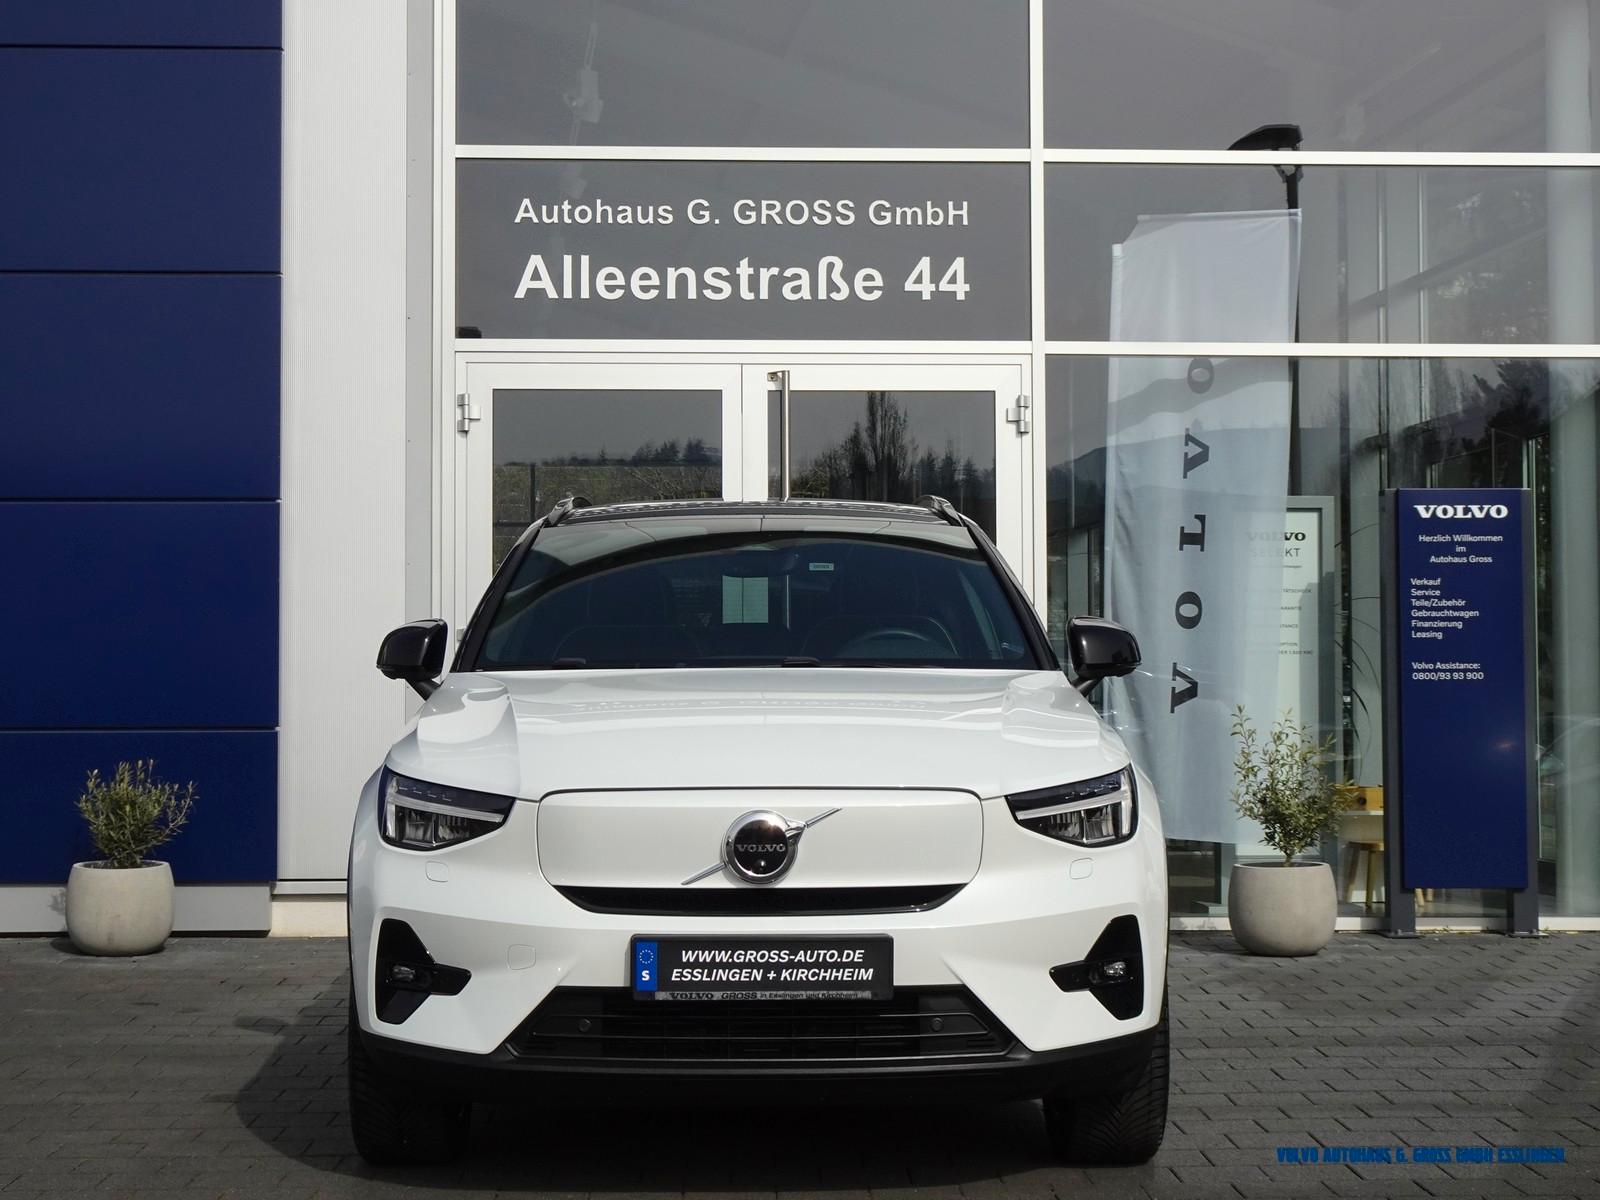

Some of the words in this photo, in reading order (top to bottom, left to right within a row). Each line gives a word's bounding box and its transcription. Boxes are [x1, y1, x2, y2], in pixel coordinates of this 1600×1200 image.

[513, 198, 674, 225] Autohaus
[687, 198, 720, 226] G.
[733, 199, 856, 226] GROSS
[868, 199, 969, 226] GmbH
[513, 254, 884, 302] Alleenstraße
[904, 256, 971, 301] 44
[1412, 504, 1509, 520] VOLVO
[1170, 356, 1215, 714] VOLVO
[1418, 534, 1451, 543] Herzlich
[1453, 534, 1504, 543] Willkommen
[1455, 544, 1467, 553] im
[1429, 555, 1468, 564] Autohaus
[1469, 555, 1493, 564] Gross
[1410, 577, 1442, 586] Verkauf
[1410, 588, 1441, 597] Service
[1410, 598, 1466, 607] Teile/Zubehör
[1411, 609, 1480, 619] Gebrauchtwagen
[1411, 619, 1463, 630] Finanzierung
[1411, 630, 1443, 640] Leasing
[1412, 661, 1435, 670] Volvo
[1435, 661, 1481, 670] Assistance:
[1412, 671, 1451, 681] 0800/93
[1453, 671, 1465, 680] 93
[1465, 671, 1484, 680] 900
[735, 843, 786, 853] VOLVO
[681, 949, 865, 963] WWW.GROSS-AUTO.DE
[641, 970, 650, 981] S
[671, 968, 762, 982] ESSLINGEN
[767, 971, 777, 981] +
[780, 968, 874, 982] KIRCHHEIM
[669, 991, 714, 1000] VOLVO
[721, 991, 758, 1000] GROSS
